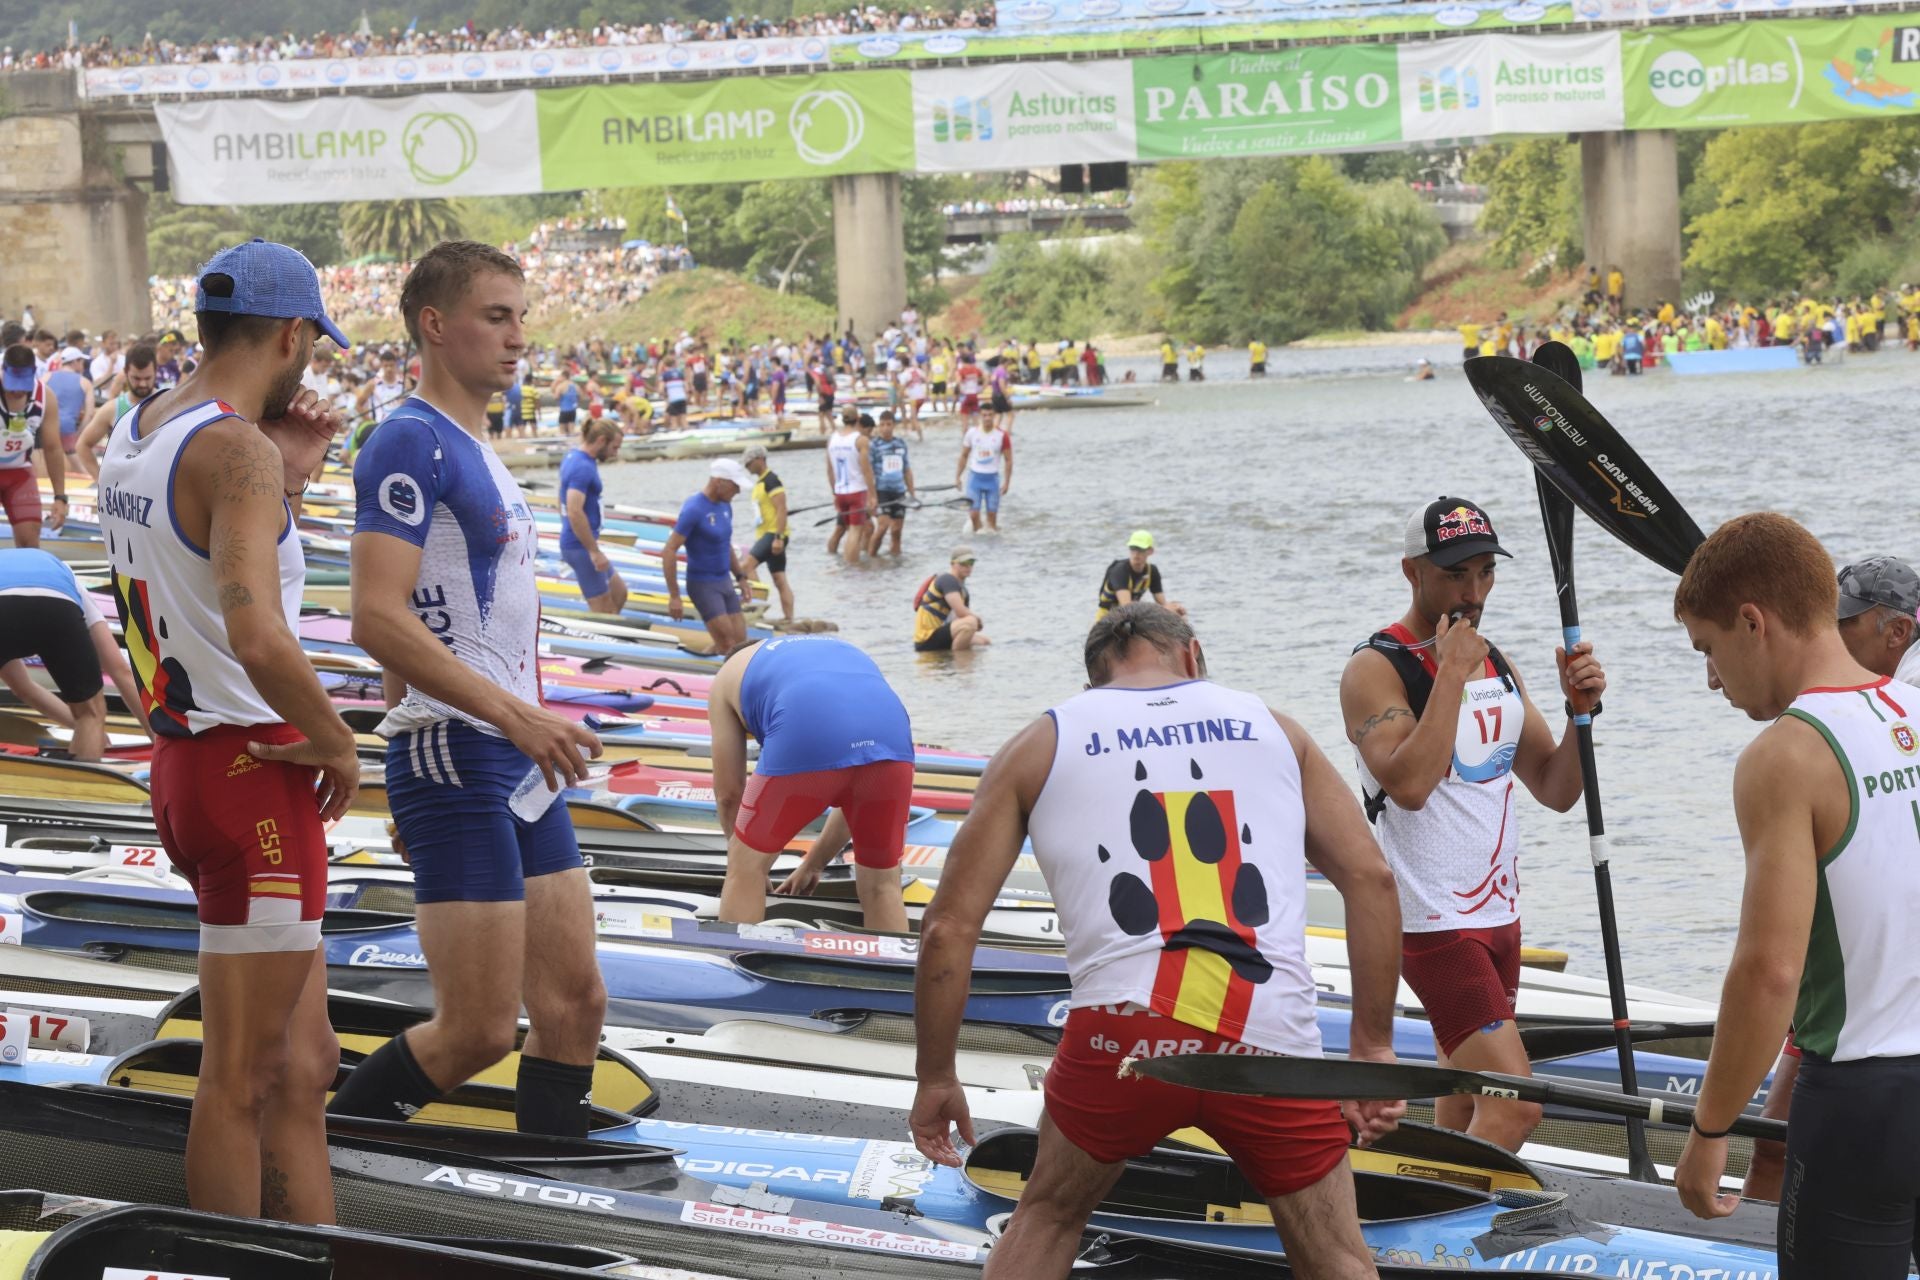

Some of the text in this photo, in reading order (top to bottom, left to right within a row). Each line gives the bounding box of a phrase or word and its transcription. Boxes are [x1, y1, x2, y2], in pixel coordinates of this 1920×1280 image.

[1495, 60, 1604, 86] Asturias
[1650, 57, 1789, 93] ecopilas
[1008, 91, 1117, 119] Asturias
[1144, 71, 1389, 122] PARAÍSO
[1554, 87, 1605, 101] natural
[603, 108, 776, 145] AMBILAMP
[1066, 115, 1118, 134] natural
[213, 128, 387, 161] AMBILAMP
[1181, 135, 1233, 153] Vuelve
[1250, 132, 1297, 149] sentir
[1300, 127, 1367, 146] Asturias
[656, 149, 736, 165] Reciclamos
[267, 166, 346, 182] Reciclamos
[1523, 383, 1588, 447] METALOLIMA
[1597, 453, 1661, 516] IMPER RUFO
[106, 481, 154, 529] SÁNCHEZ
[1437, 519, 1492, 542] Red Bull
[1471, 688, 1504, 701] Unicaja
[1085, 717, 1259, 757] J. MARTINEZ
[1473, 705, 1503, 745] 17
[122, 847, 157, 867] 22
[256, 818, 284, 866] ESP
[30, 1014, 68, 1041] 17
[1090, 1033, 1120, 1053] de
[422, 1165, 616, 1211] ASTOR
[690, 1211, 800, 1239] Sistemas
[807, 1228, 968, 1259] Constructivos
